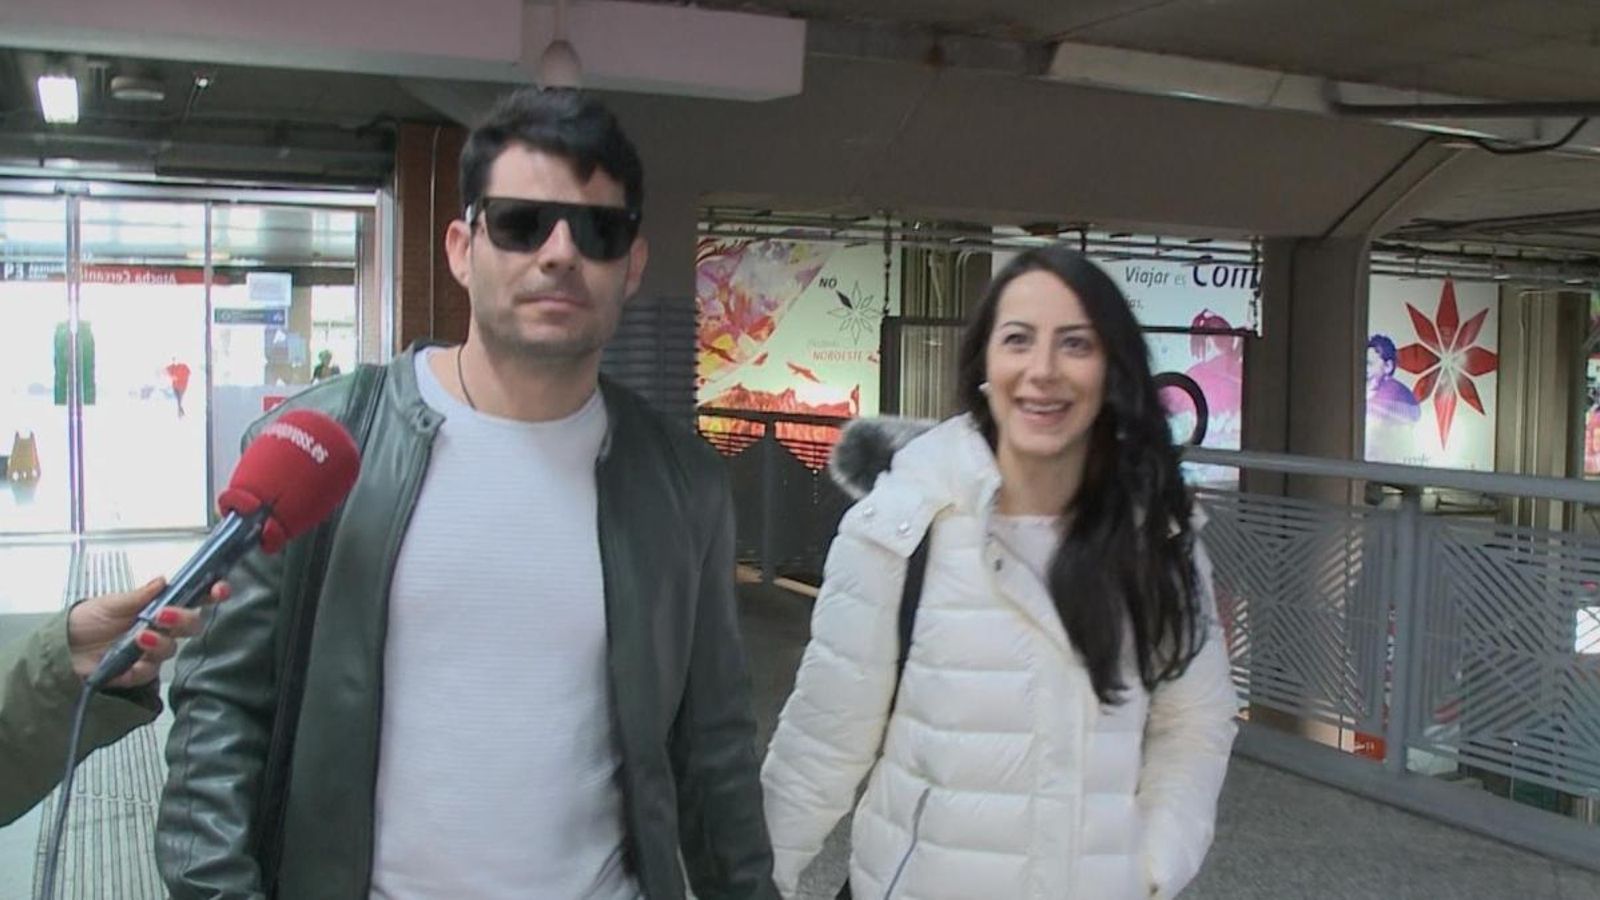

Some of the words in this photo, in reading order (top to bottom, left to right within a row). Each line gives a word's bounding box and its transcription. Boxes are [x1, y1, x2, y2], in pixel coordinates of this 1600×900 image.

[1125, 266, 1170, 287] Viajar
[819, 277, 838, 289] NO
[812, 350, 863, 361] NOROESTE
